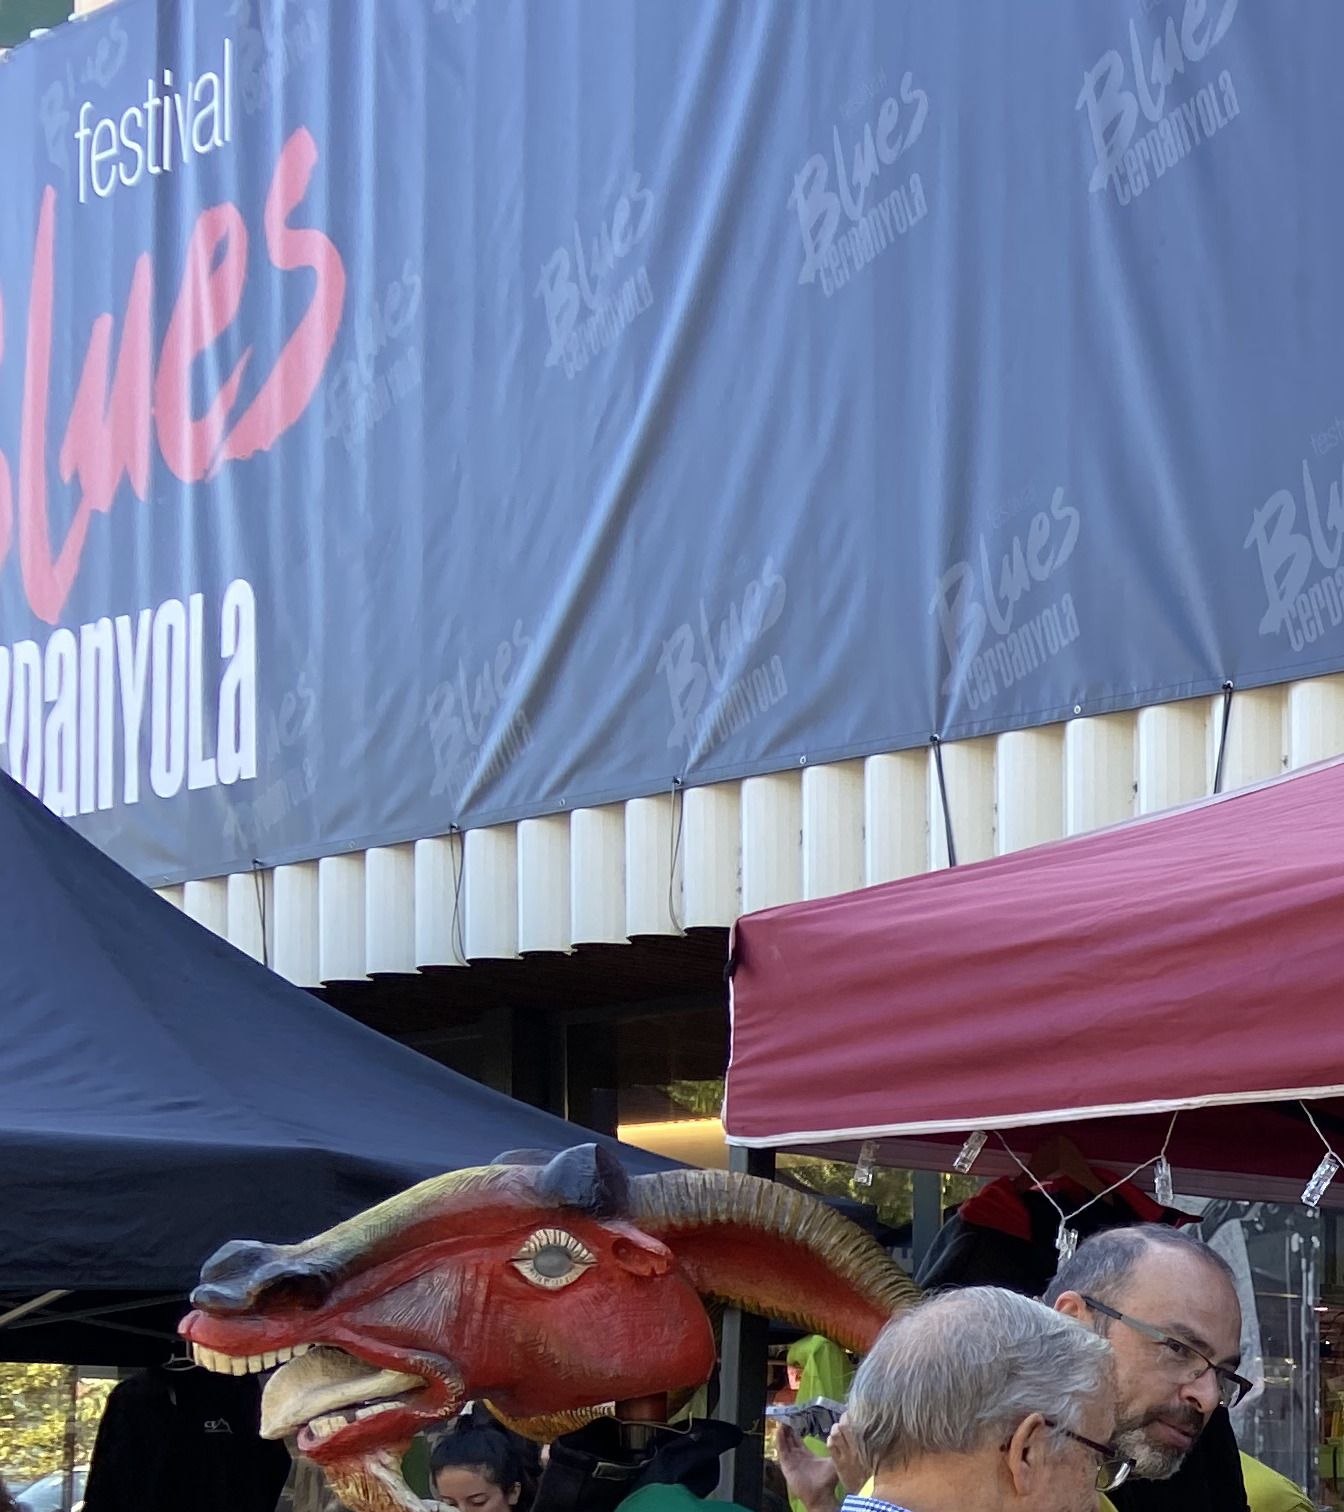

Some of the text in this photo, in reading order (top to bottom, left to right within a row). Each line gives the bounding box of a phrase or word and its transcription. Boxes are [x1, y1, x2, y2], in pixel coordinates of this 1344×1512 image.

[73, 37, 234, 204] festival
[787, 71, 929, 285] Blues
[534, 170, 654, 368] Blues
[0, 125, 347, 625] lues
[927, 486, 1081, 697] Blues
